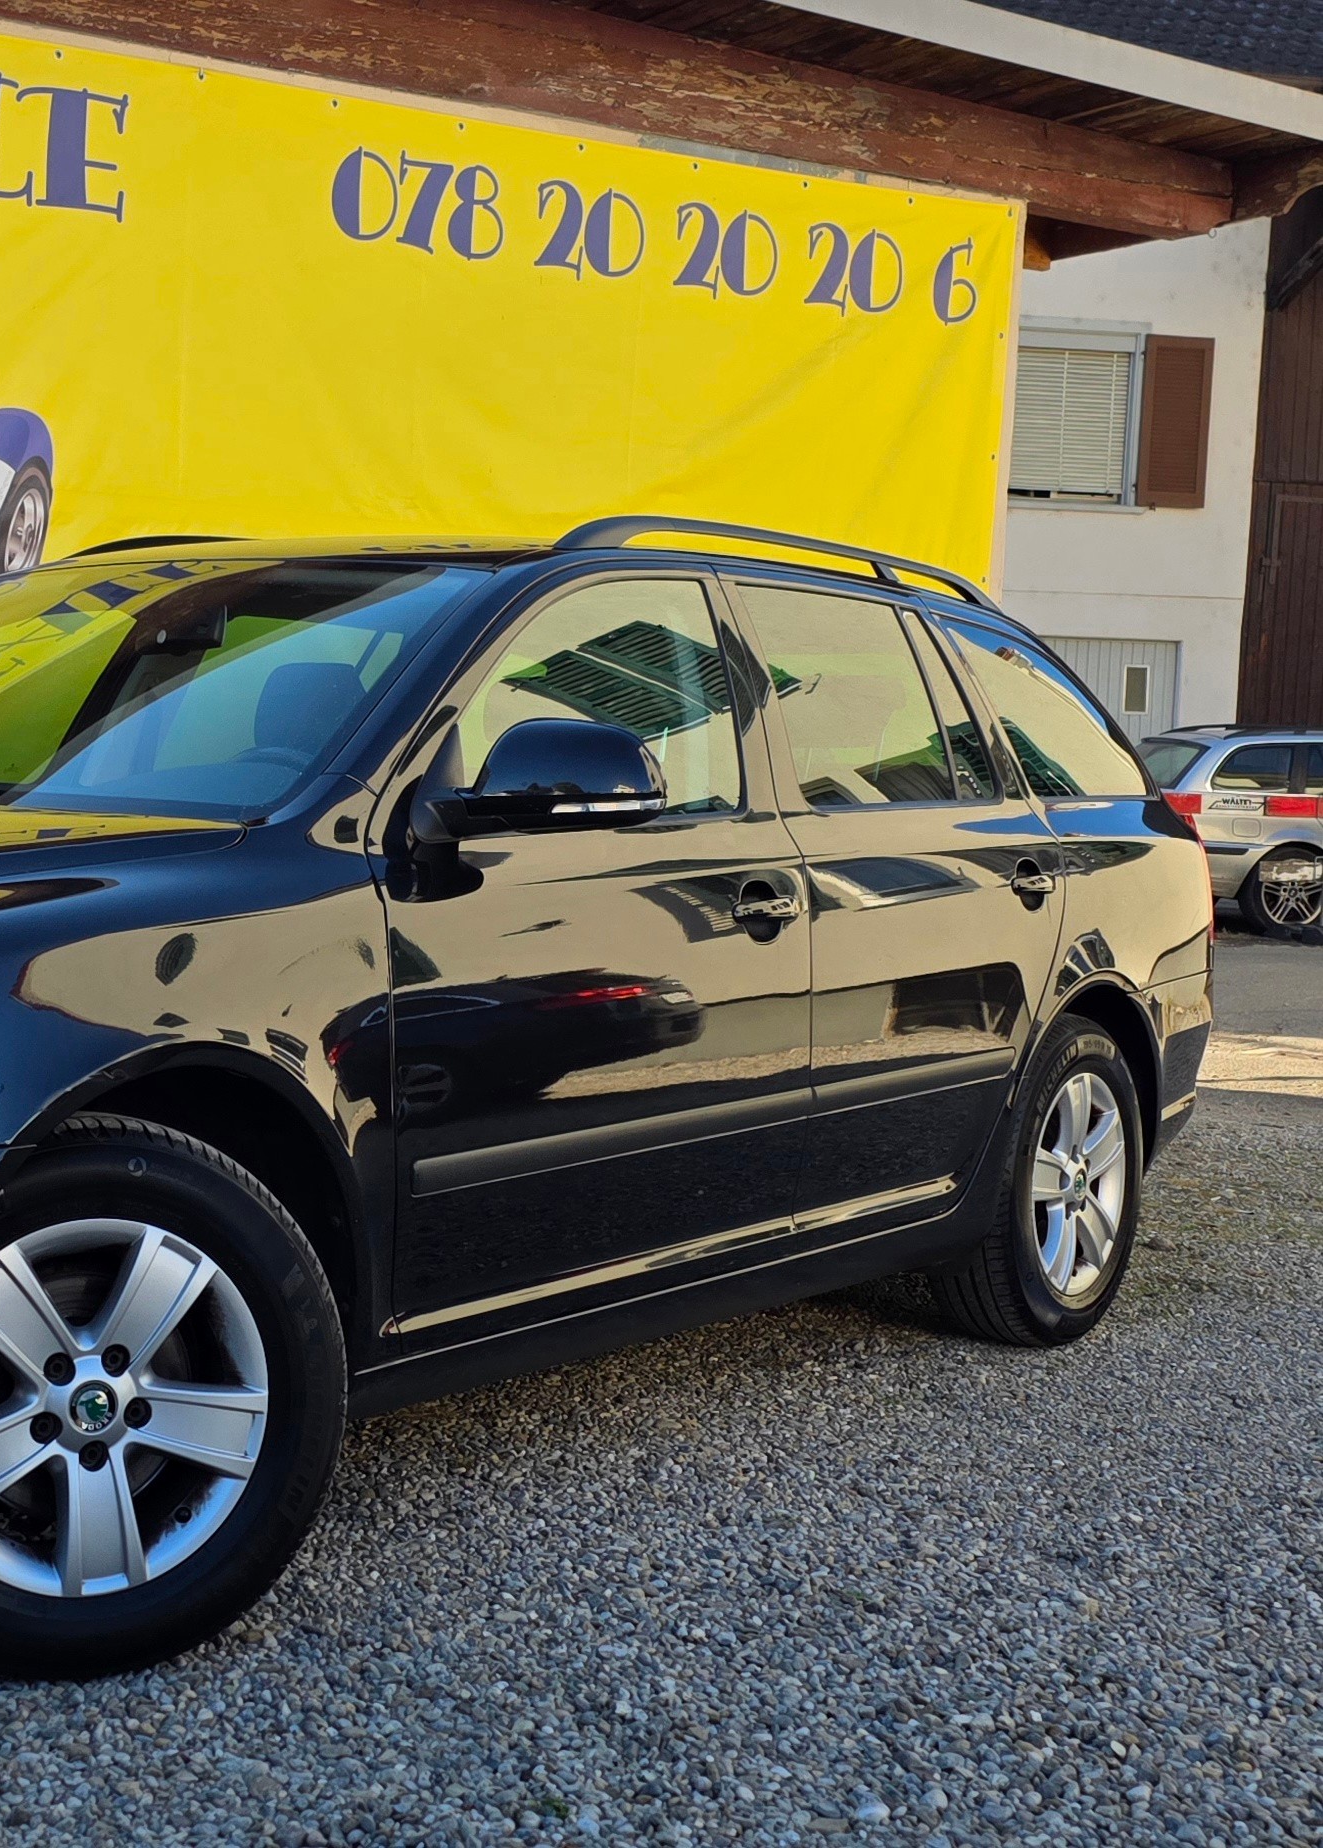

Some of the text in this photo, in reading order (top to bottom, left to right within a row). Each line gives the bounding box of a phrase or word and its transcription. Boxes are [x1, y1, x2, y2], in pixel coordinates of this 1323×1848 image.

[331, 146, 977, 326] 078 20 20 20 6
